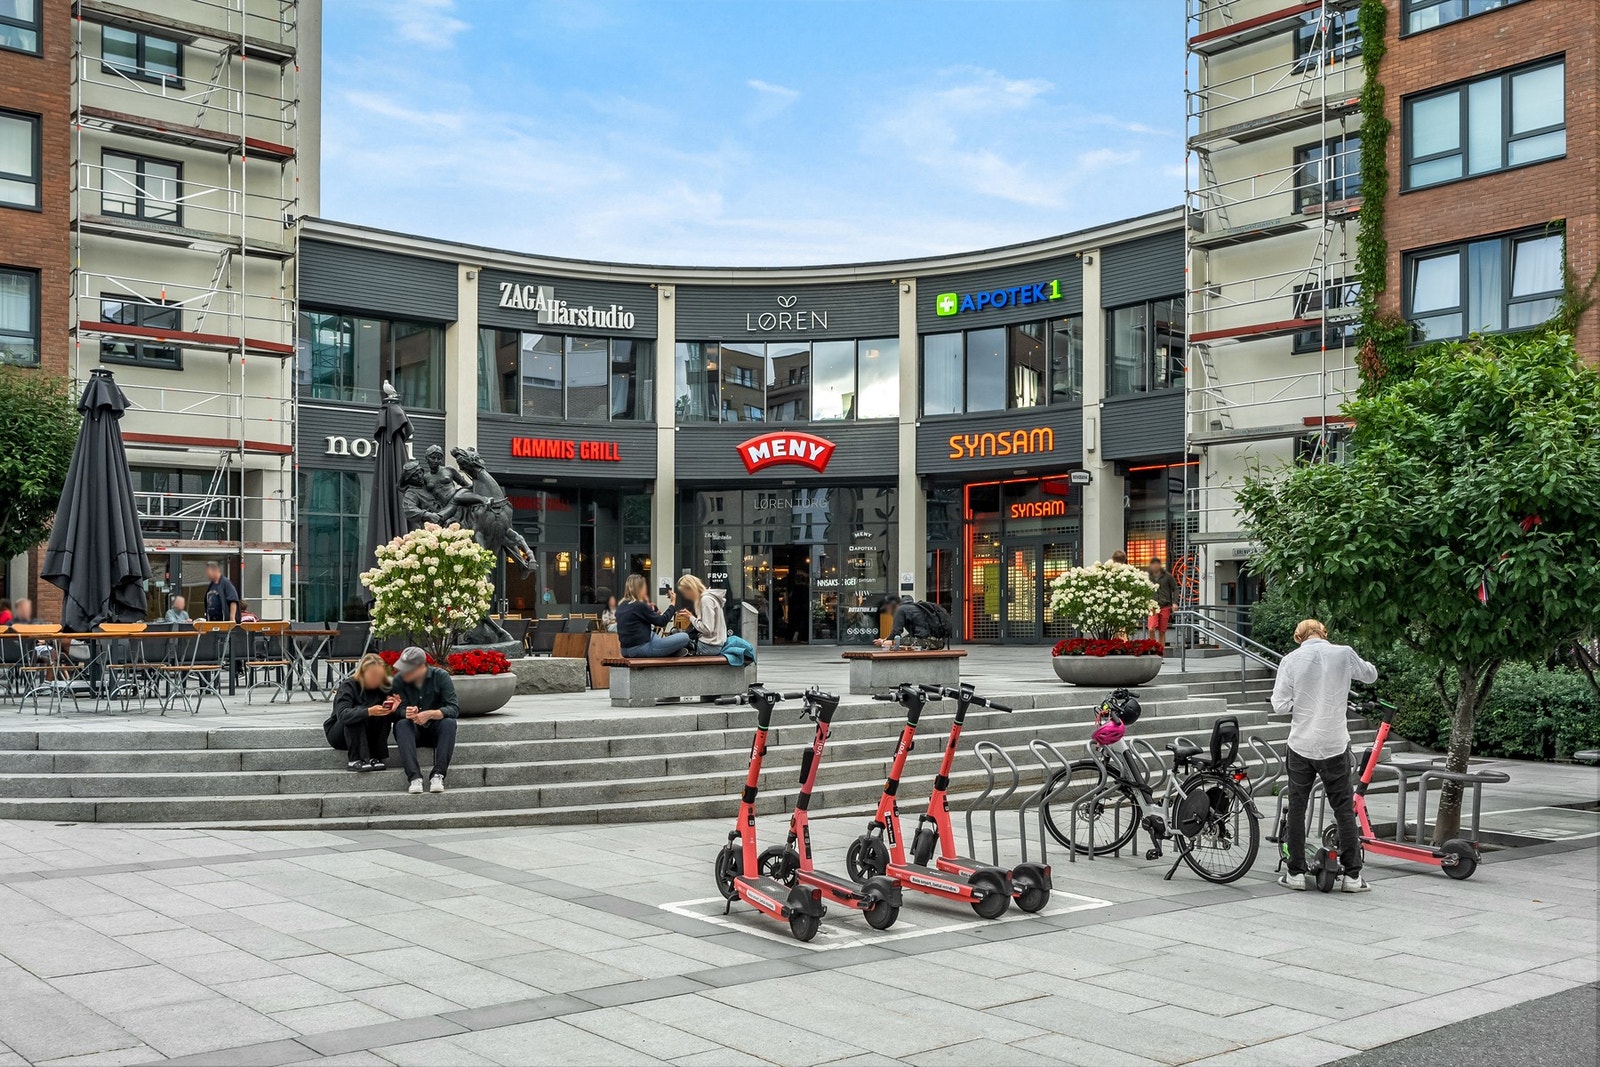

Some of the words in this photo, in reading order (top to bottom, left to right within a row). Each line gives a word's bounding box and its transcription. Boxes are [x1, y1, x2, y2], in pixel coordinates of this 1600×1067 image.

[499, 281, 548, 312] ZAGA
[546, 299, 635, 330] Hårstudio
[960, 281, 1047, 313] APOTEK
[1049, 279, 1063, 300] 1
[746, 310, 828, 331] LØREN
[325, 434, 416, 461] nori
[512, 437, 575, 460] KAMMIS
[580, 441, 622, 462] GRILL
[747, 438, 825, 464] MENY
[948, 426, 1054, 459] SYNSAM
[753, 498, 793, 510] LØREN
[1011, 500, 1066, 519] SYNSAM
